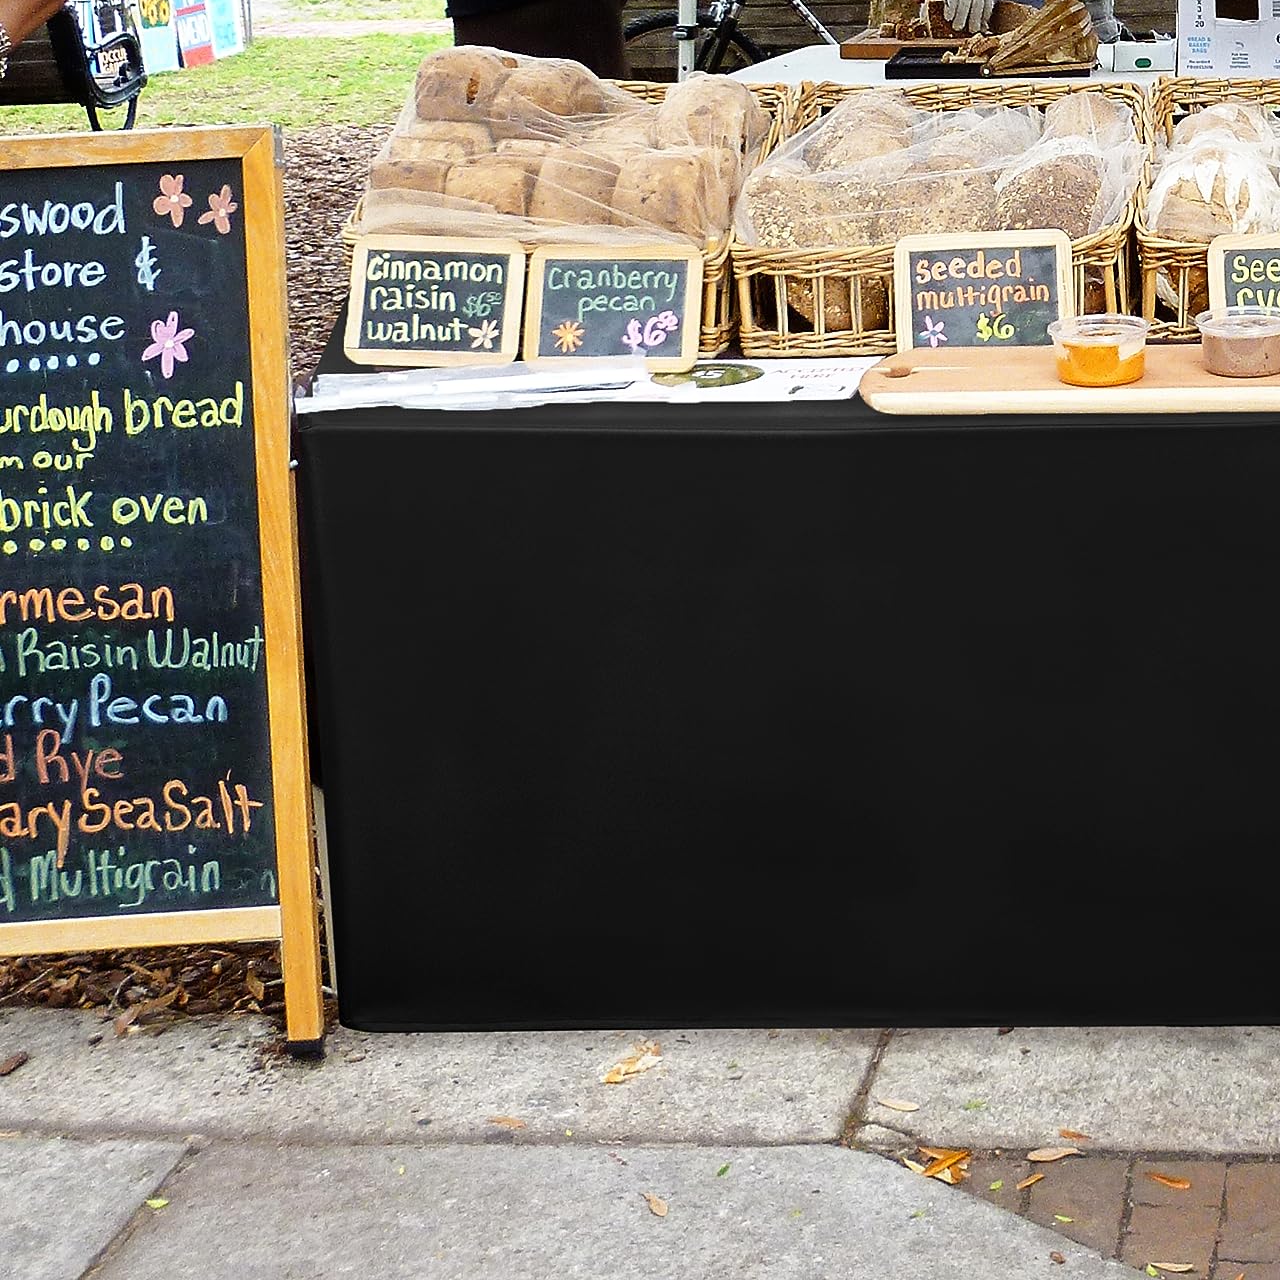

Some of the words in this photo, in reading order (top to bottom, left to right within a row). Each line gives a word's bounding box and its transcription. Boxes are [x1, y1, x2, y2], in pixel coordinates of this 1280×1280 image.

[1194, 20, 1205, 28] 20
[0, 181, 126, 238] swood
[0, 248, 108, 293] store
[135, 235, 162, 291] &
[369, 284, 458, 312] raisin
[577, 294, 656, 321] pecan
[916, 277, 1051, 317] multigrain
[366, 314, 469, 342] walnut
[976, 313, 1015, 342] $6
[124, 382, 244, 435] bread
[33, 450, 95, 470] our
[0, 484, 95, 533] brick
[111, 493, 209, 526] oven
[16, 628, 138, 677] Raisin
[147, 625, 264, 672] Walnut
[88, 673, 229, 727] Pecan
[35, 728, 125, 796] Rye
[30, 845, 222, 910] Multigrain
